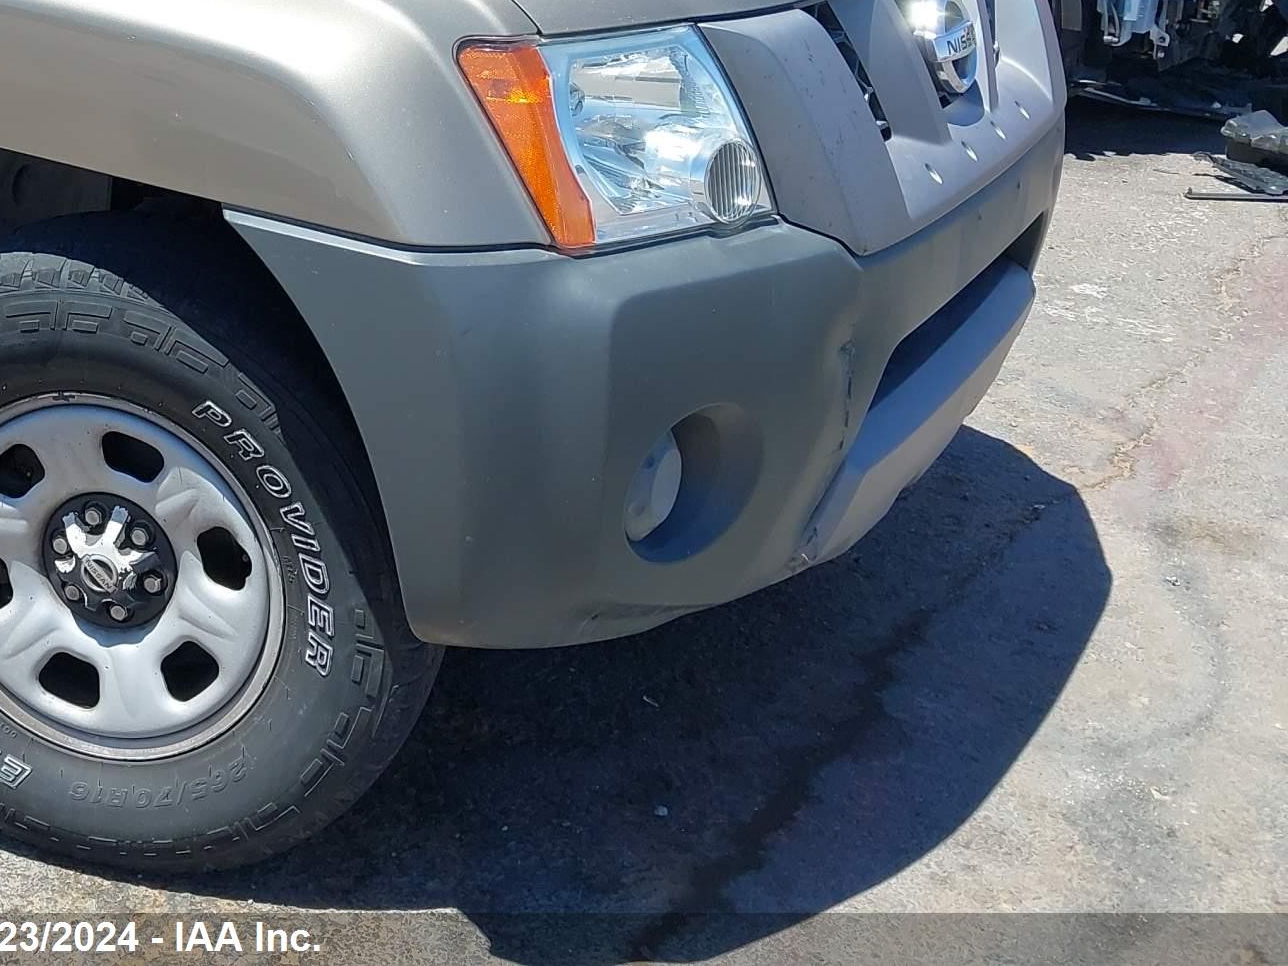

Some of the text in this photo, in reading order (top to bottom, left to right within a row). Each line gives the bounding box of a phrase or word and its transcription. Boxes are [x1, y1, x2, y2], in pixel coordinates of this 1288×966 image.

[192, 400, 334, 677] PROVIDER
[85, 557, 113, 590] NISSAN
[70, 753, 249, 809] 265/70R16
